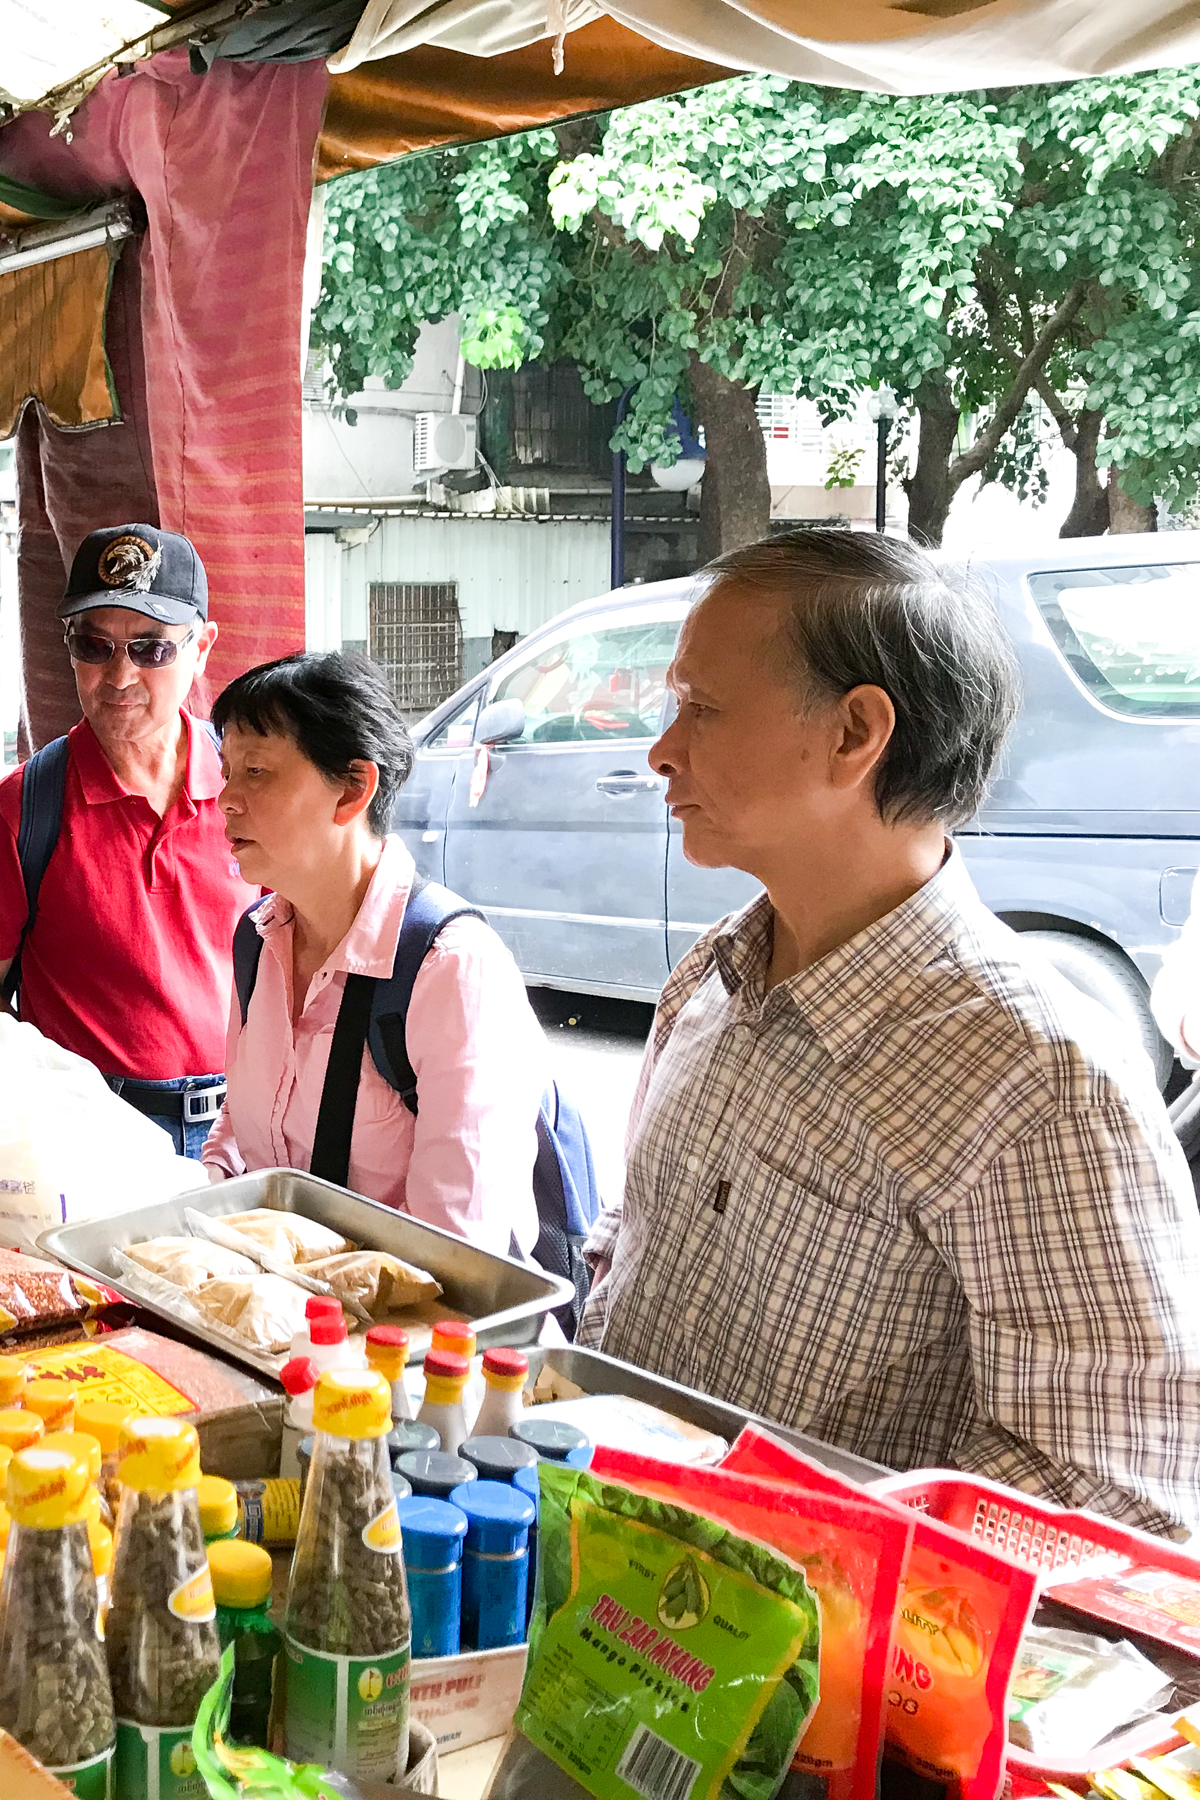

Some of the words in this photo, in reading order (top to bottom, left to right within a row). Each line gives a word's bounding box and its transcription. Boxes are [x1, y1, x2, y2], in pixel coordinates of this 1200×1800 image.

[628, 1558, 657, 1581] FIRST
[900, 1608, 940, 1636] LITY
[579, 1626, 627, 1667] Mango
[589, 1593, 630, 1633] THU
[617, 1615, 659, 1654] ZAR
[645, 1636, 717, 1694] MYAING
